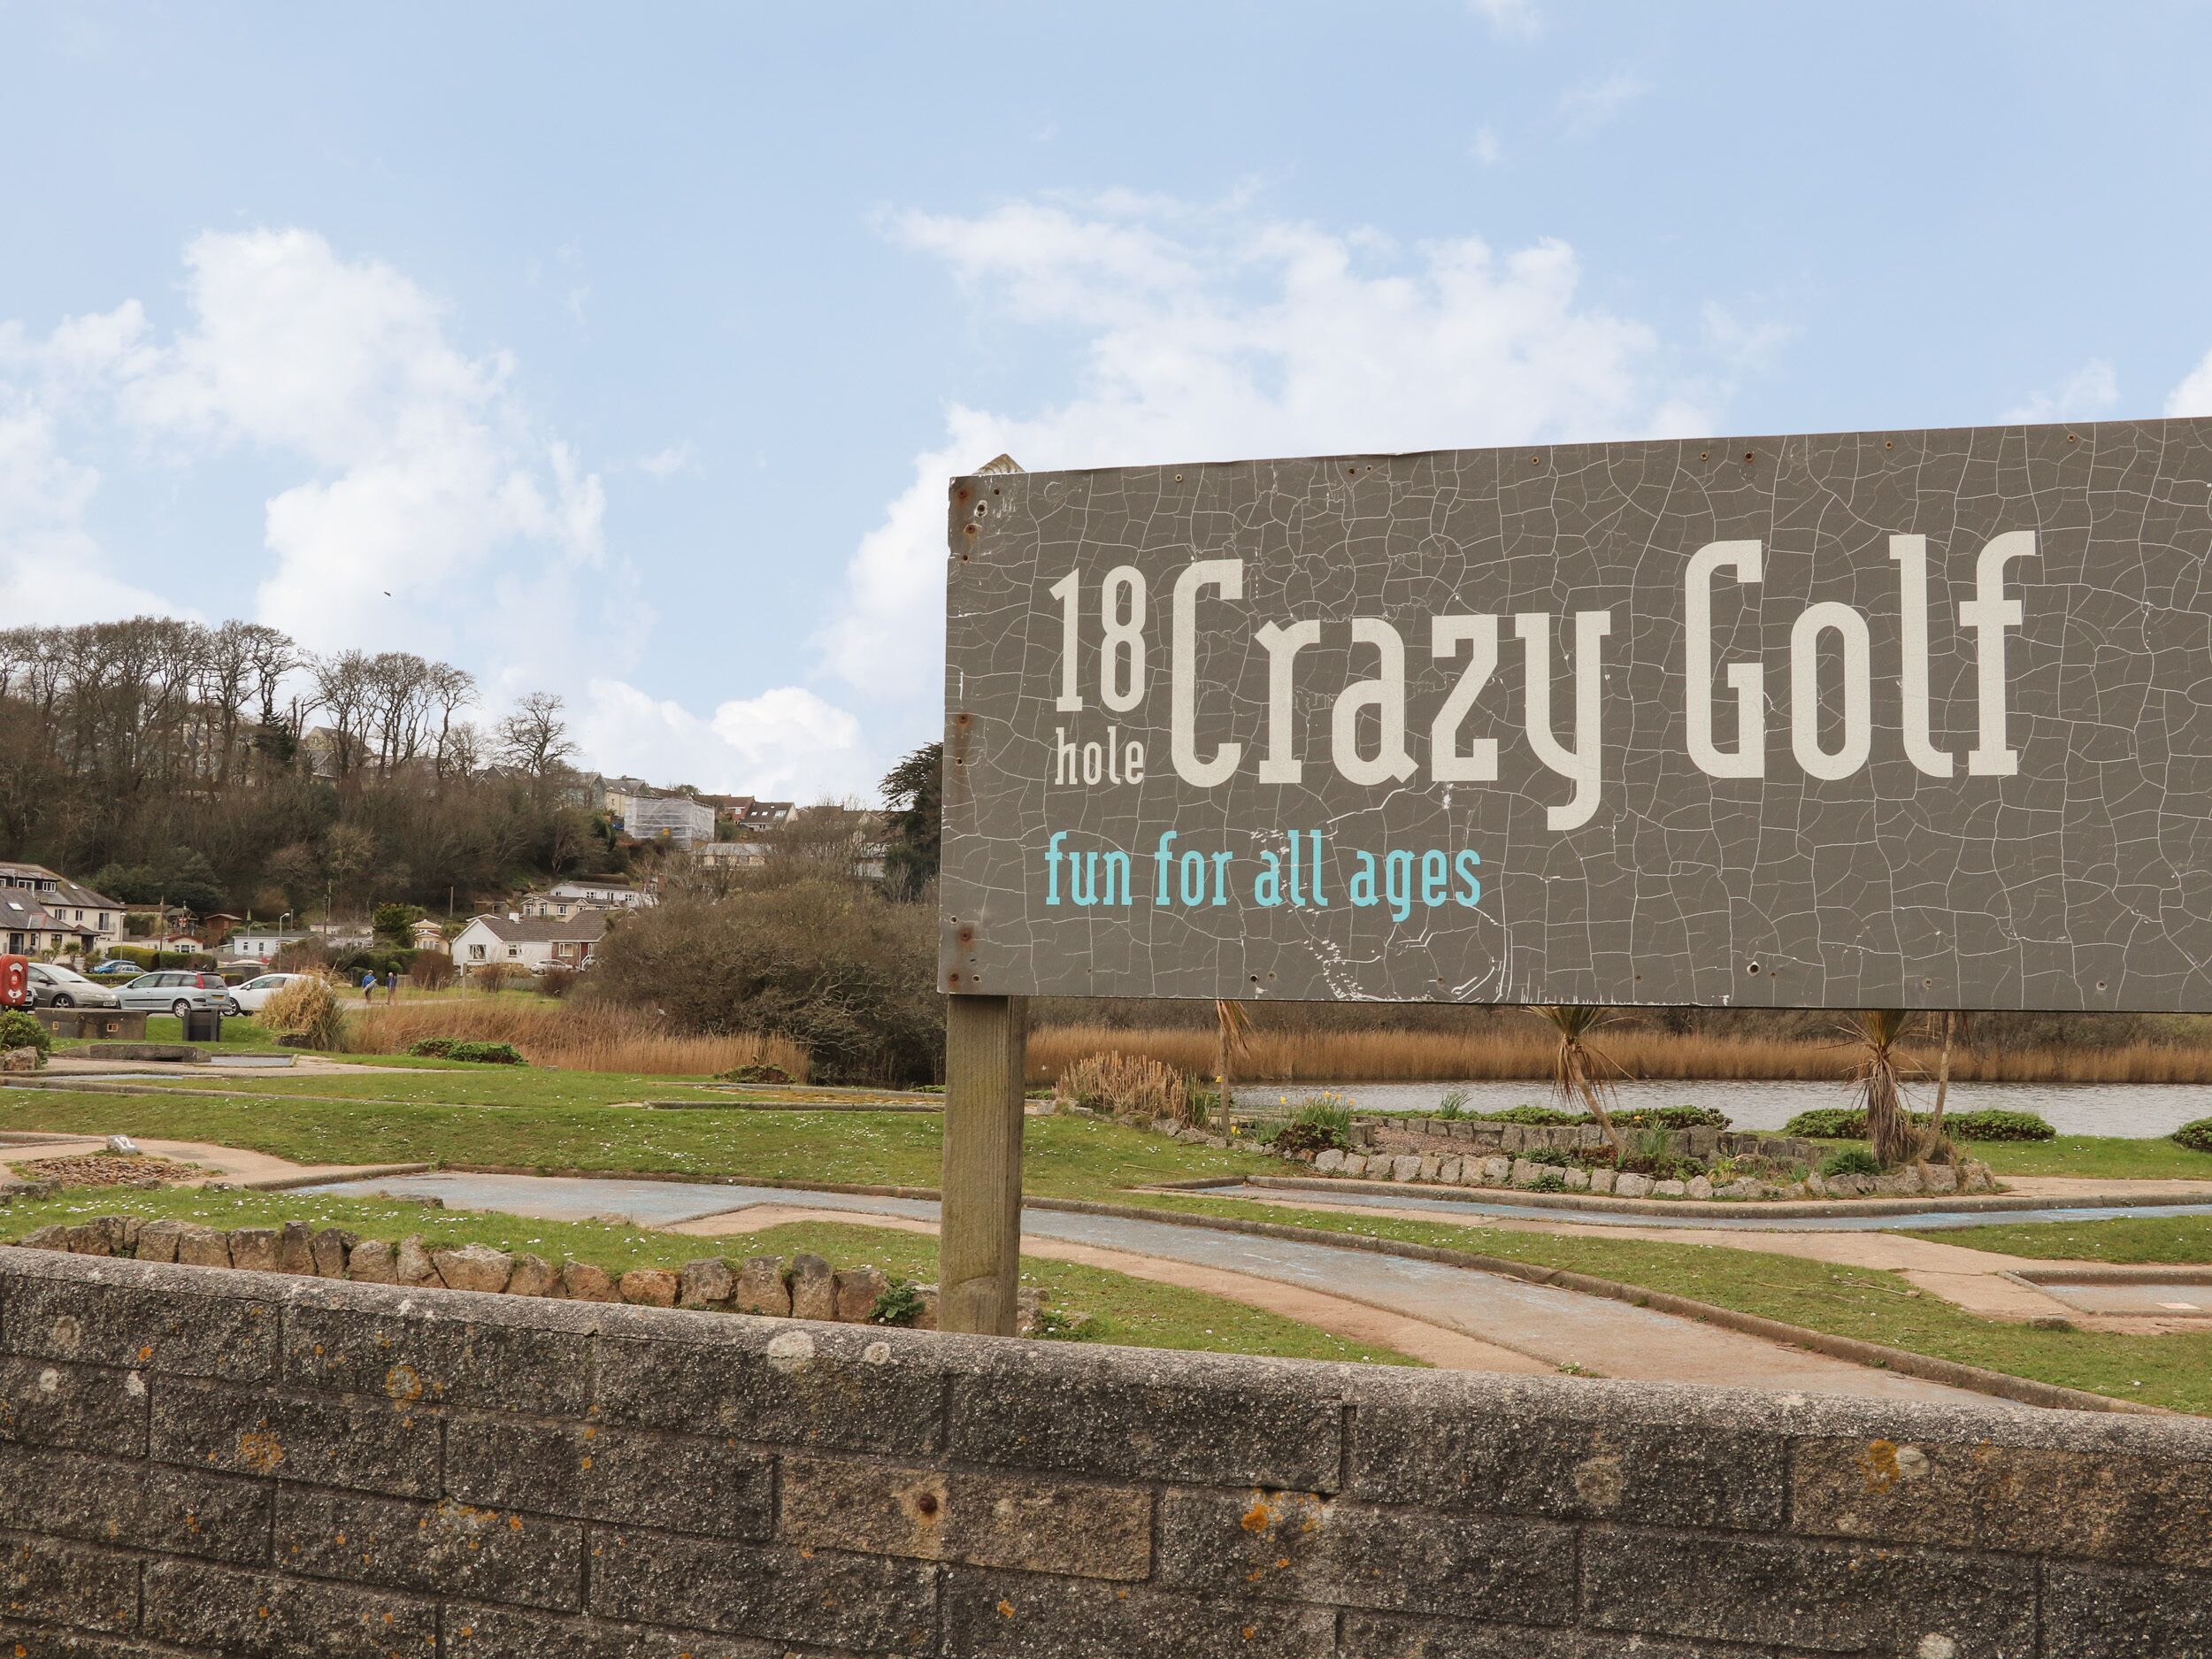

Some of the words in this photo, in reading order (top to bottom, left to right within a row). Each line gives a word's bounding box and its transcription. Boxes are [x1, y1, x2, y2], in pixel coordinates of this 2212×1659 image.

[1048, 565, 1147, 713] 18
[1171, 558, 1611, 831] Crazy
[1685, 530, 2037, 781] Golf
[1054, 726, 1145, 786] hole
[1045, 830, 1133, 906] fun
[1154, 830, 1233, 906] for
[1254, 829, 1329, 906] all
[1349, 849, 1481, 923] ages
[113, 1136, 136, 1149] 12
